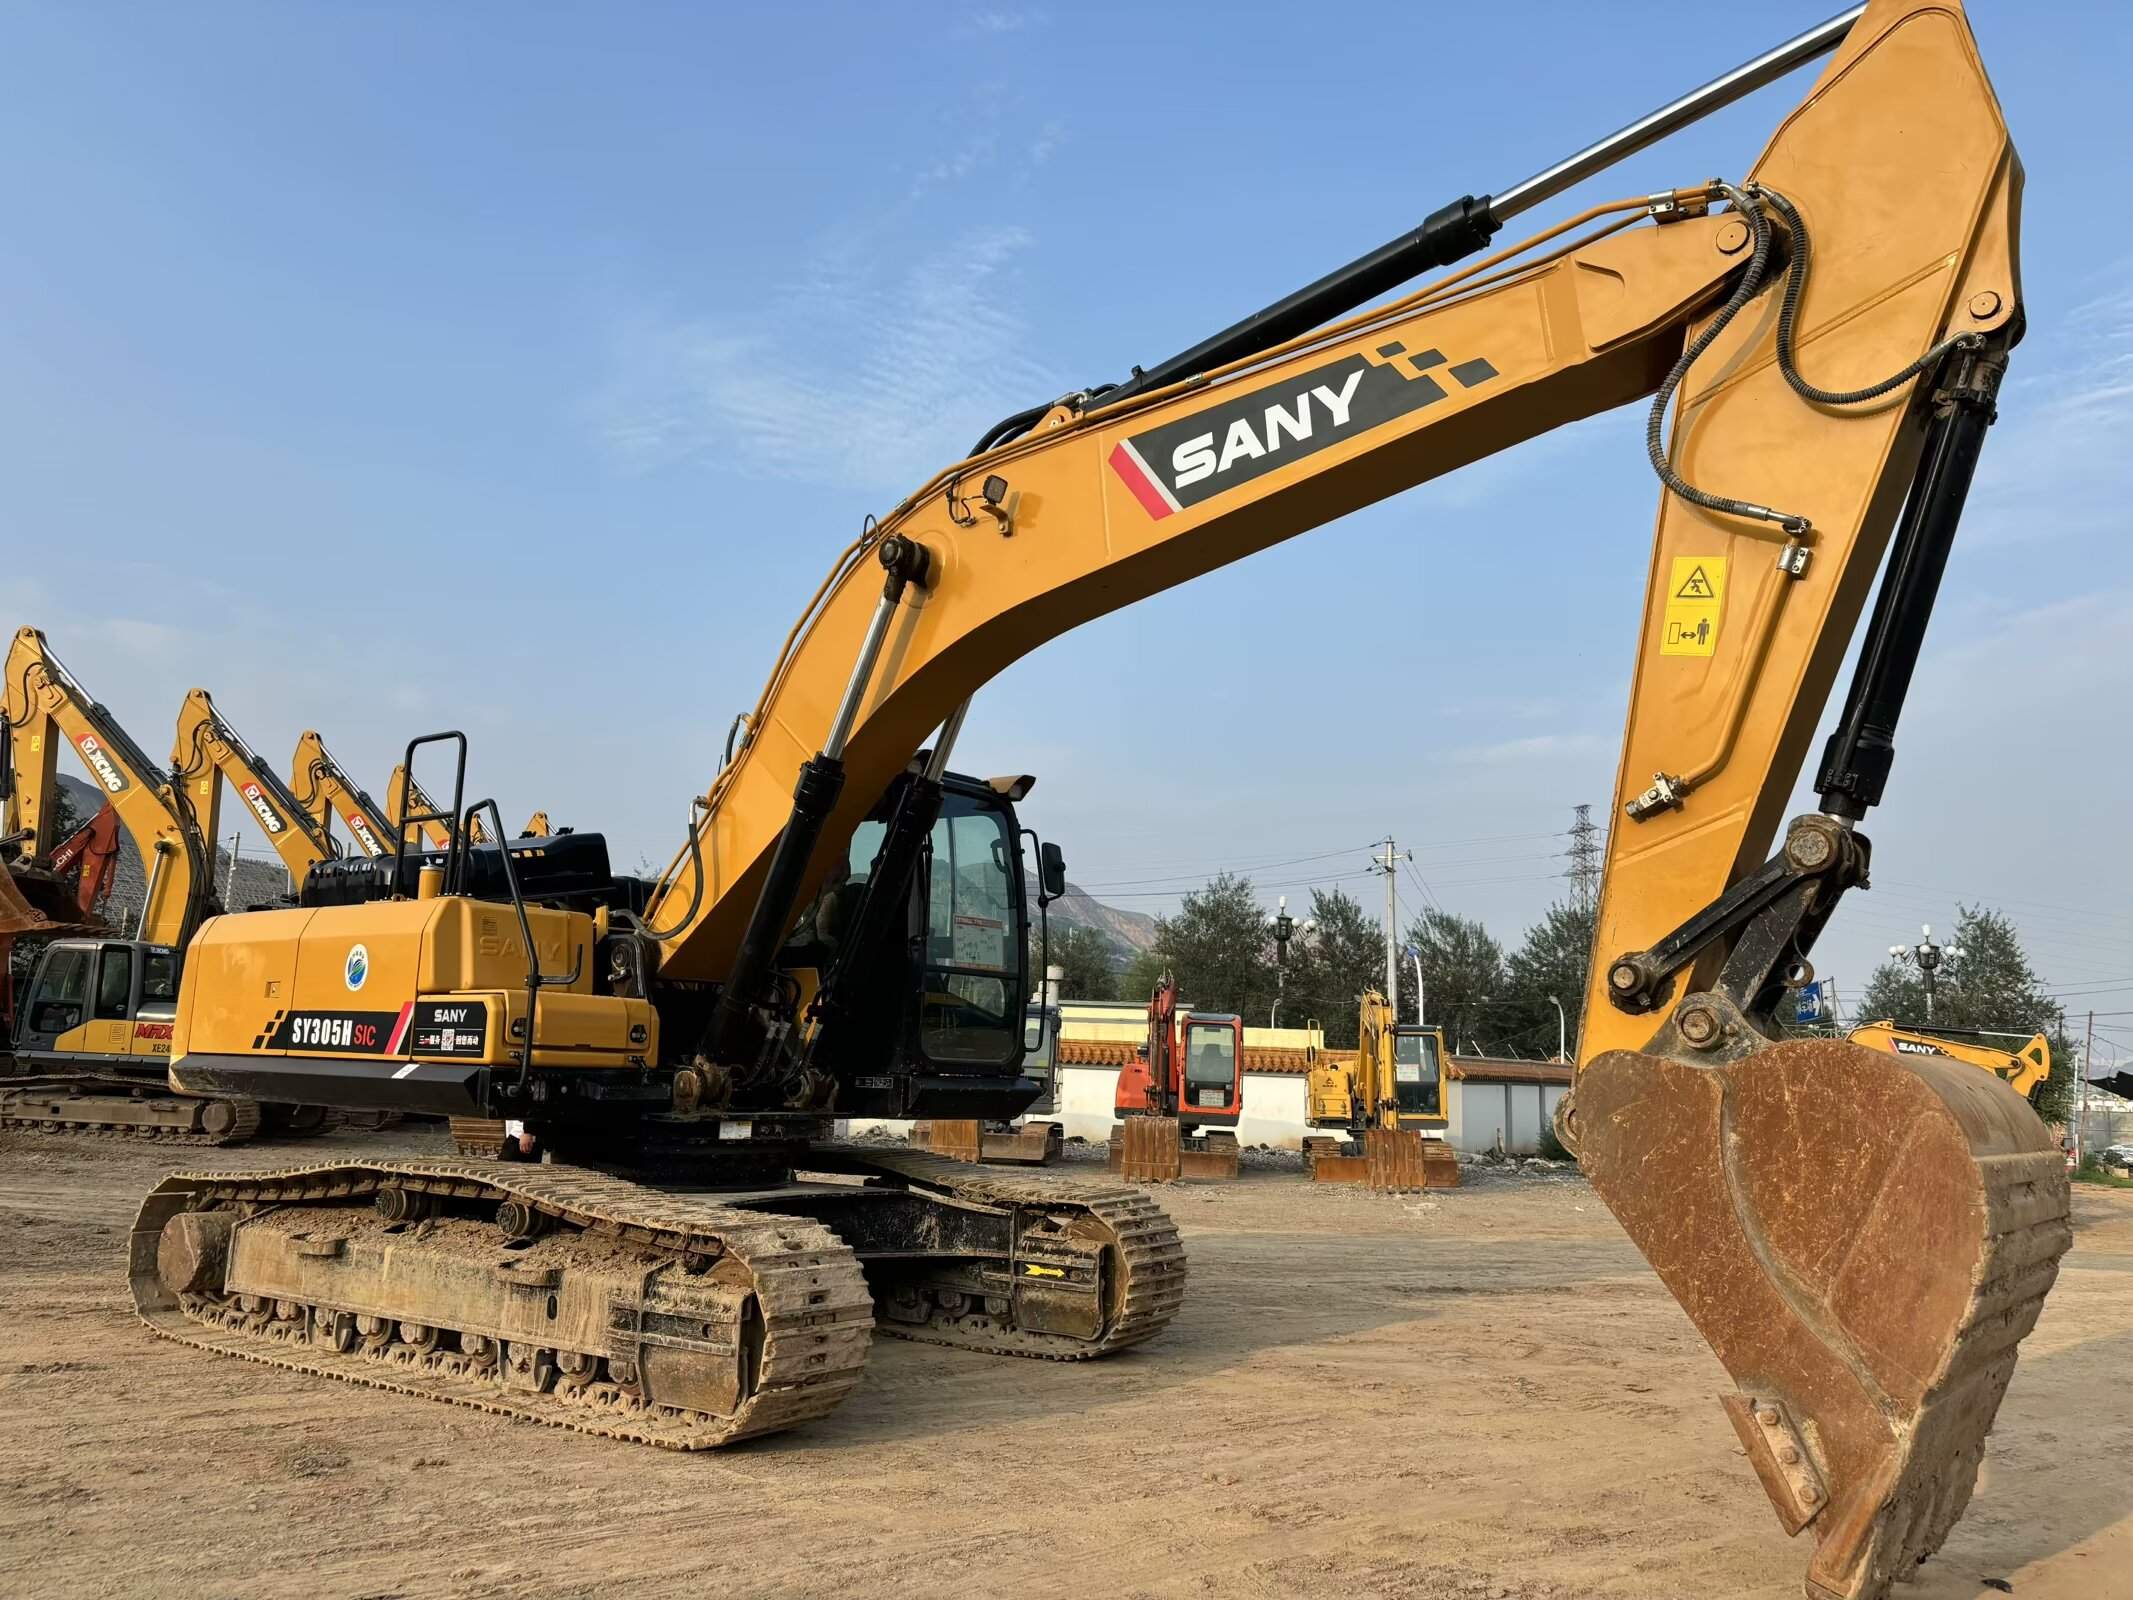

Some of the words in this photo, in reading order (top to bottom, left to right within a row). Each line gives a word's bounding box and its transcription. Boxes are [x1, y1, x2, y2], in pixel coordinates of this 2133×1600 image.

[1172, 368, 1365, 490] SANY
[89, 750, 122, 792] XCMG
[252, 796, 281, 833] XCMG
[359, 826, 382, 857] XCMG
[434, 1009, 467, 1023] SANY
[292, 1017, 353, 1046] SY305H
[354, 1024, 377, 1047] SIC
[1898, 1042, 1937, 1055] SANY
